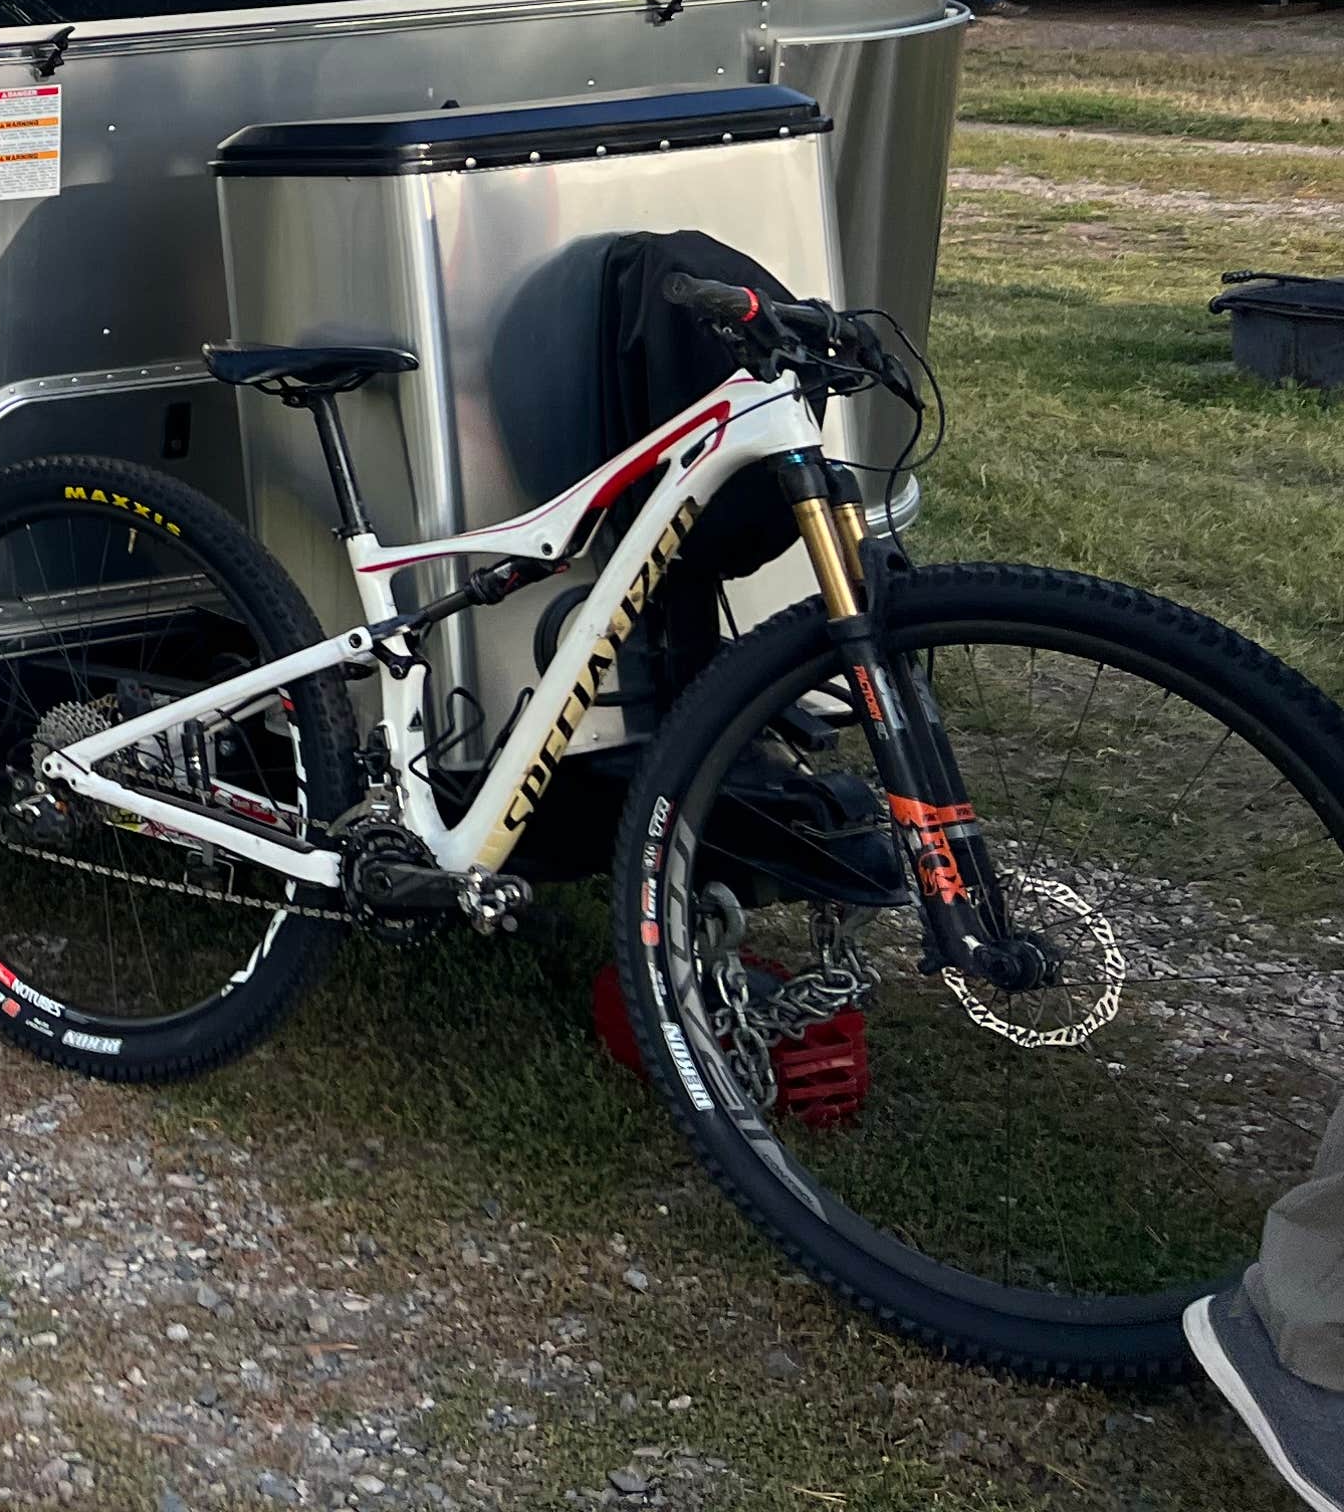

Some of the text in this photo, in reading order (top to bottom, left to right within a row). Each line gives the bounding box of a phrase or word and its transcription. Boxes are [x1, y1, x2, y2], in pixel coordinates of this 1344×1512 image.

[65, 486, 181, 536] MAXXIS
[918, 828, 969, 906] FOX
[661, 1021, 716, 1112] REKON
